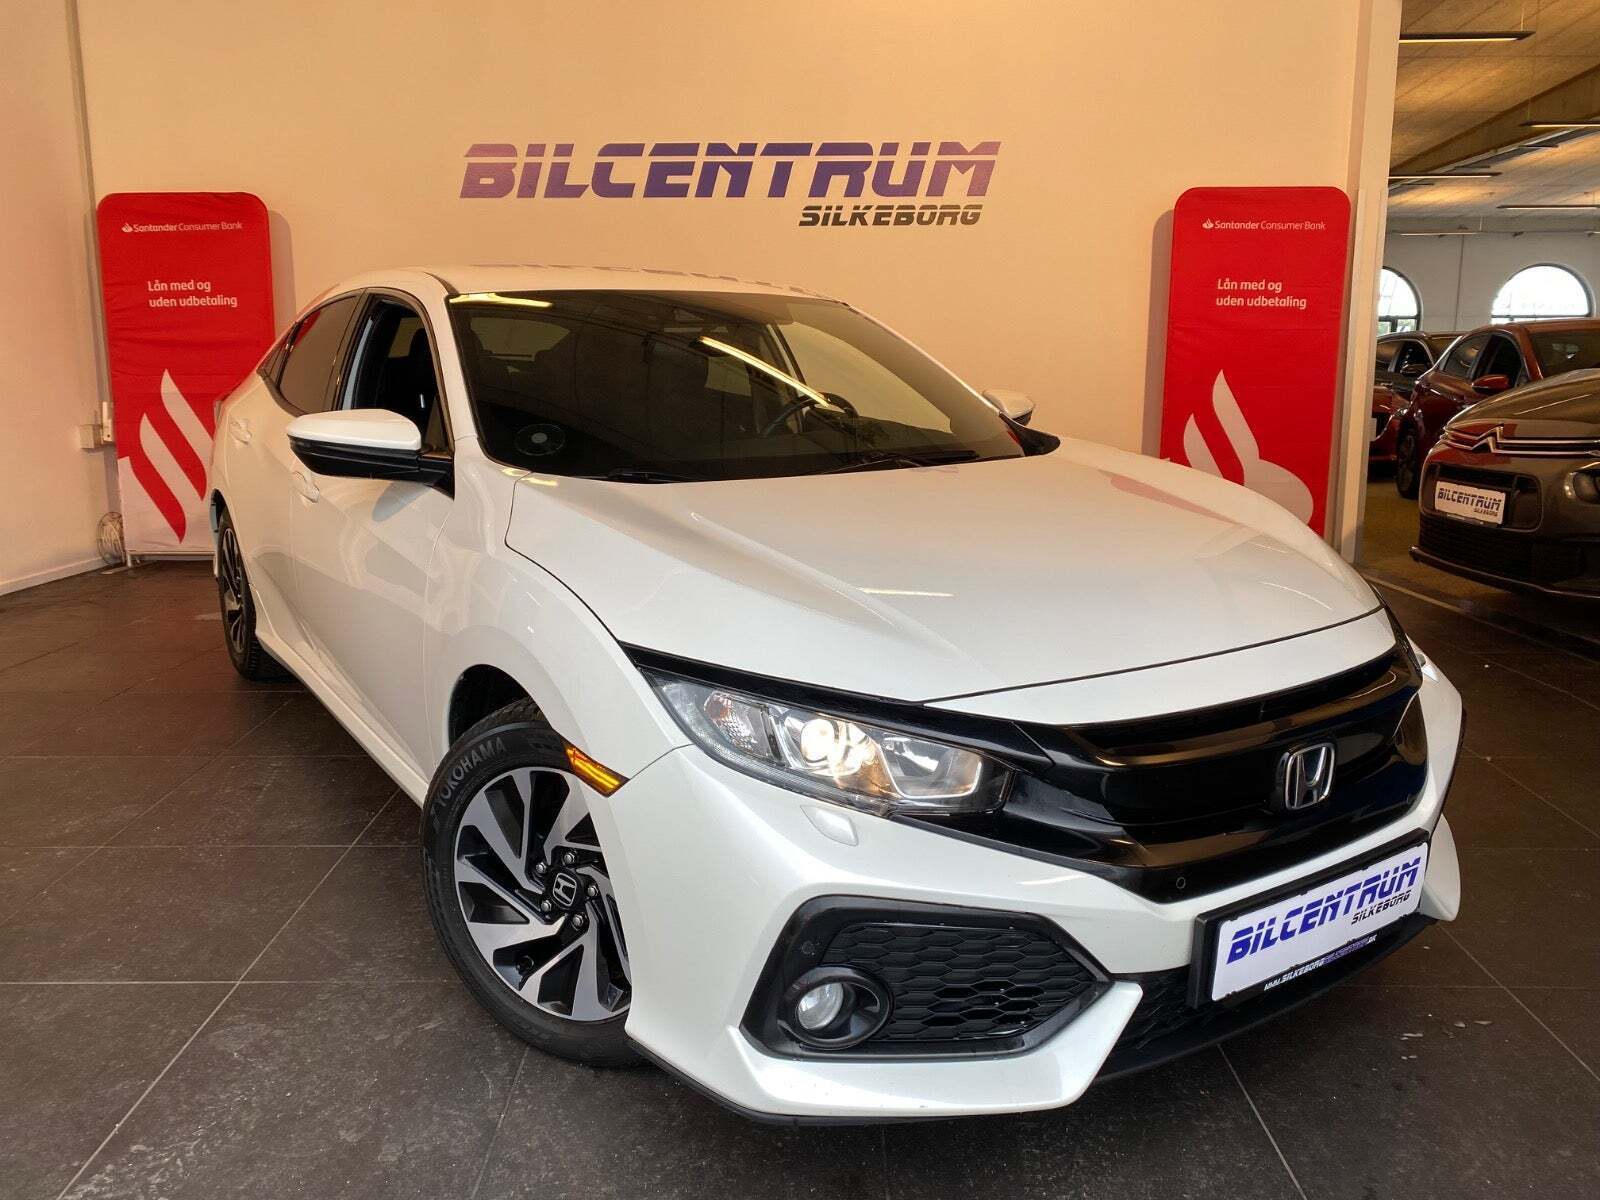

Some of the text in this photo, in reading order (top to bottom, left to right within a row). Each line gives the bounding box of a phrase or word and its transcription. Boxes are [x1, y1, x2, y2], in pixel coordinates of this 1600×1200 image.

[459, 140, 1002, 199] BILCENTRUM
[798, 203, 983, 227] SILKEBORG
[1214, 220, 1327, 230] Santander Consumer Bank
[133, 220, 243, 233] Santander Consumer Bank
[147, 279, 211, 293] Lån med og
[1217, 277, 1282, 294] Lån med og
[148, 294, 238, 308] uden udbetaling
[1215, 295, 1307, 310] uden udbetaling
[1437, 487, 1502, 511] BILCENTRUM
[438, 736, 508, 808] YOKOHAMA
[1226, 856, 1422, 965] BILCENTRUM
[1351, 889, 1412, 925] SILKEBORG
